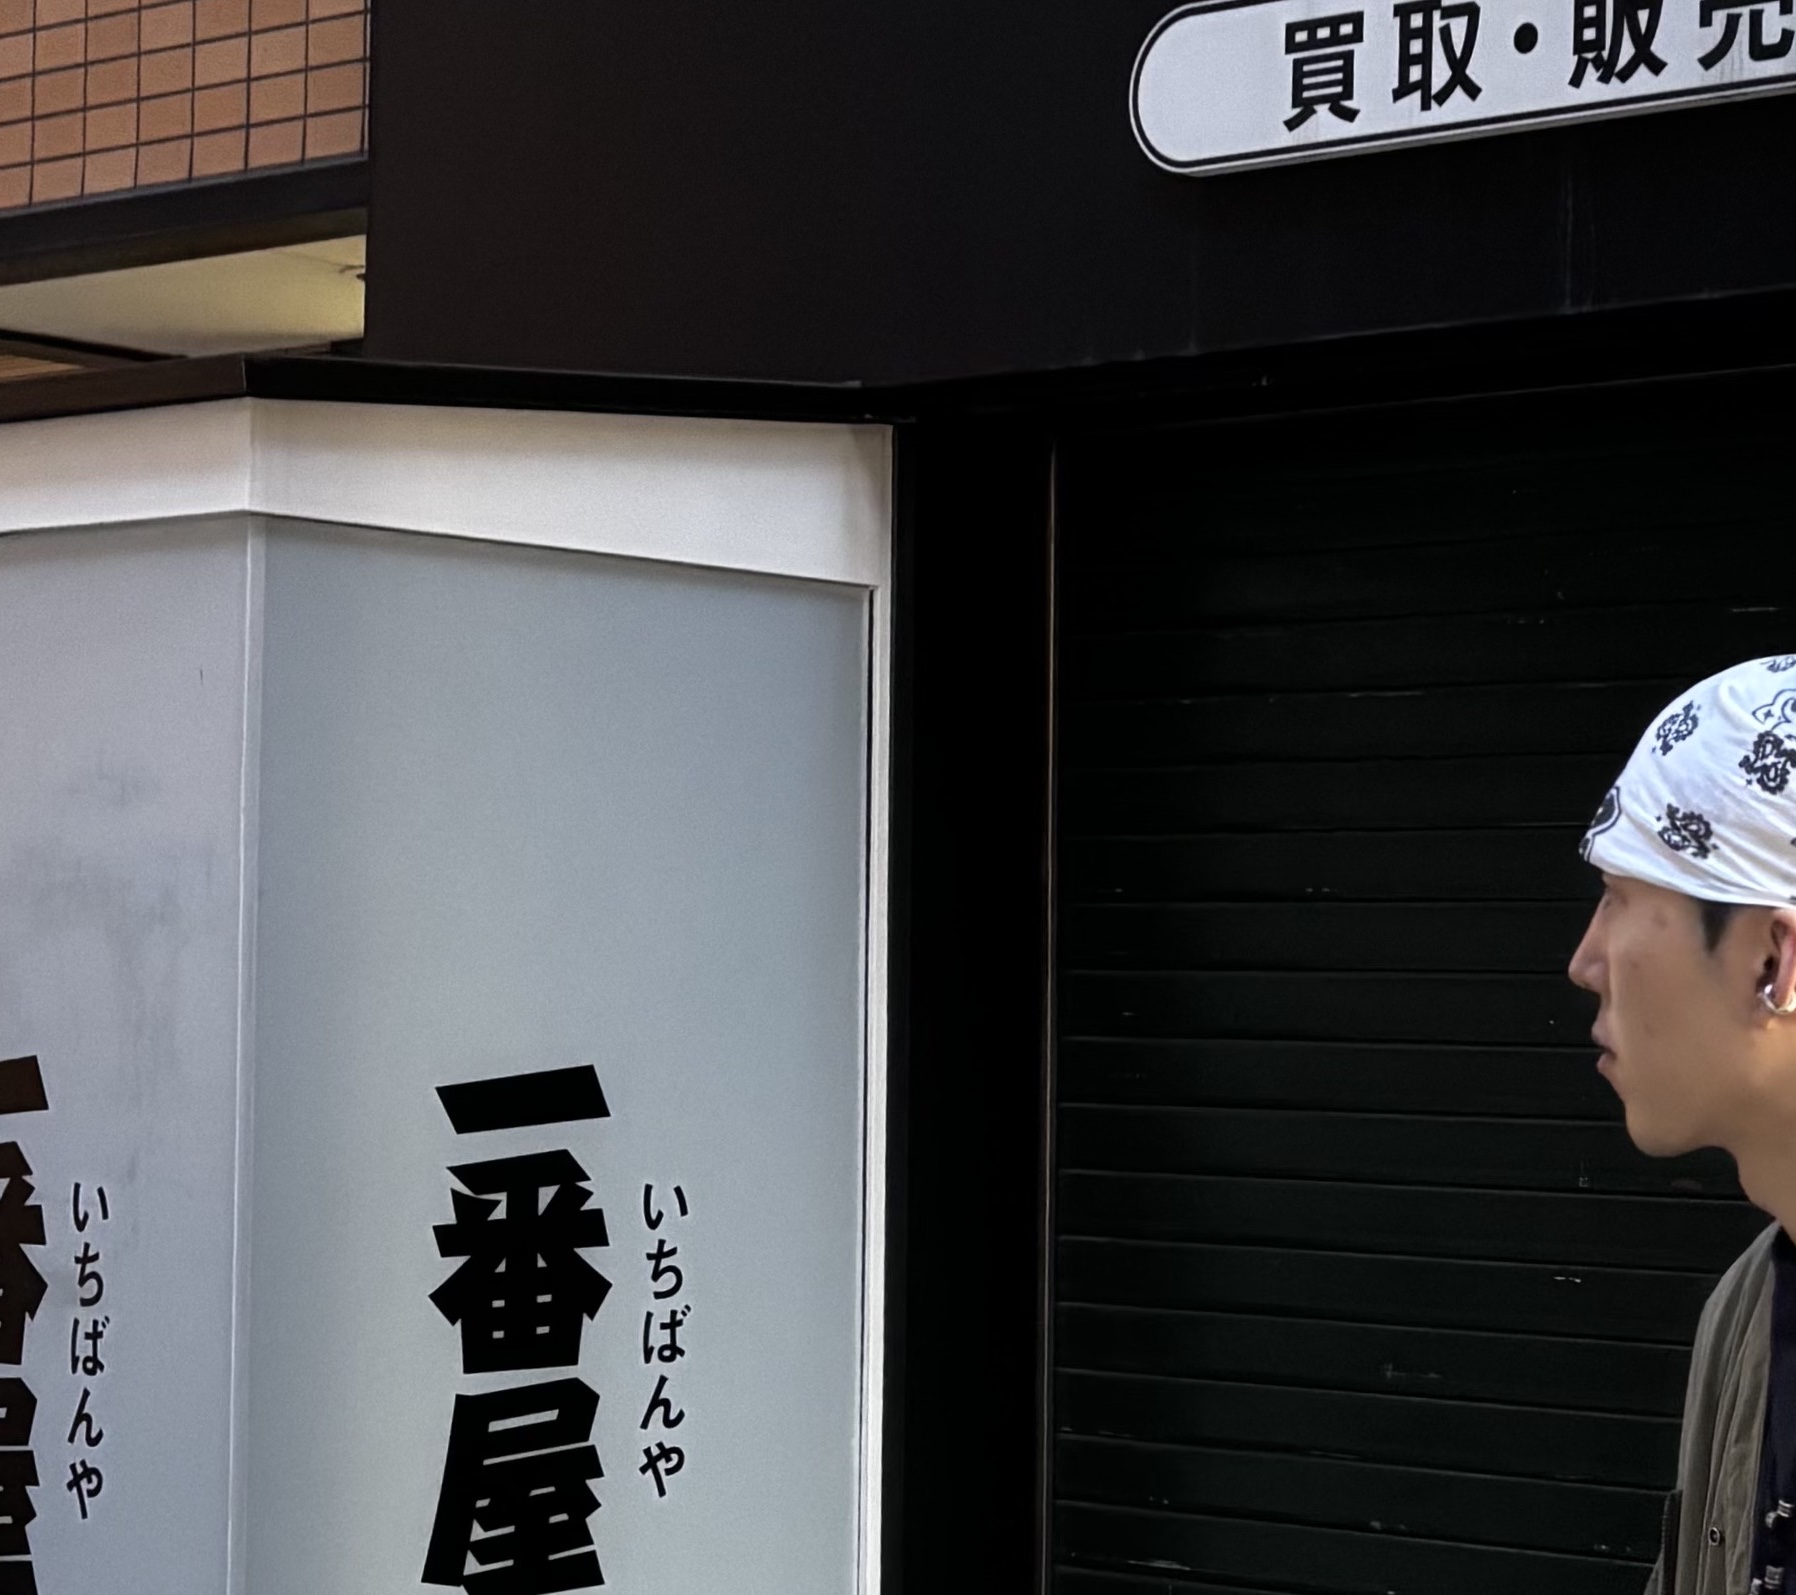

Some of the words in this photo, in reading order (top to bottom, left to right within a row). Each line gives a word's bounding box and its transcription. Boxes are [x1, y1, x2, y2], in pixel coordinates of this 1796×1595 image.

[1282, 0, 1796, 133] 買取・販売
[67, 1182, 110, 1520] いちばんや
[639, 1182, 691, 1498] いちばんや
